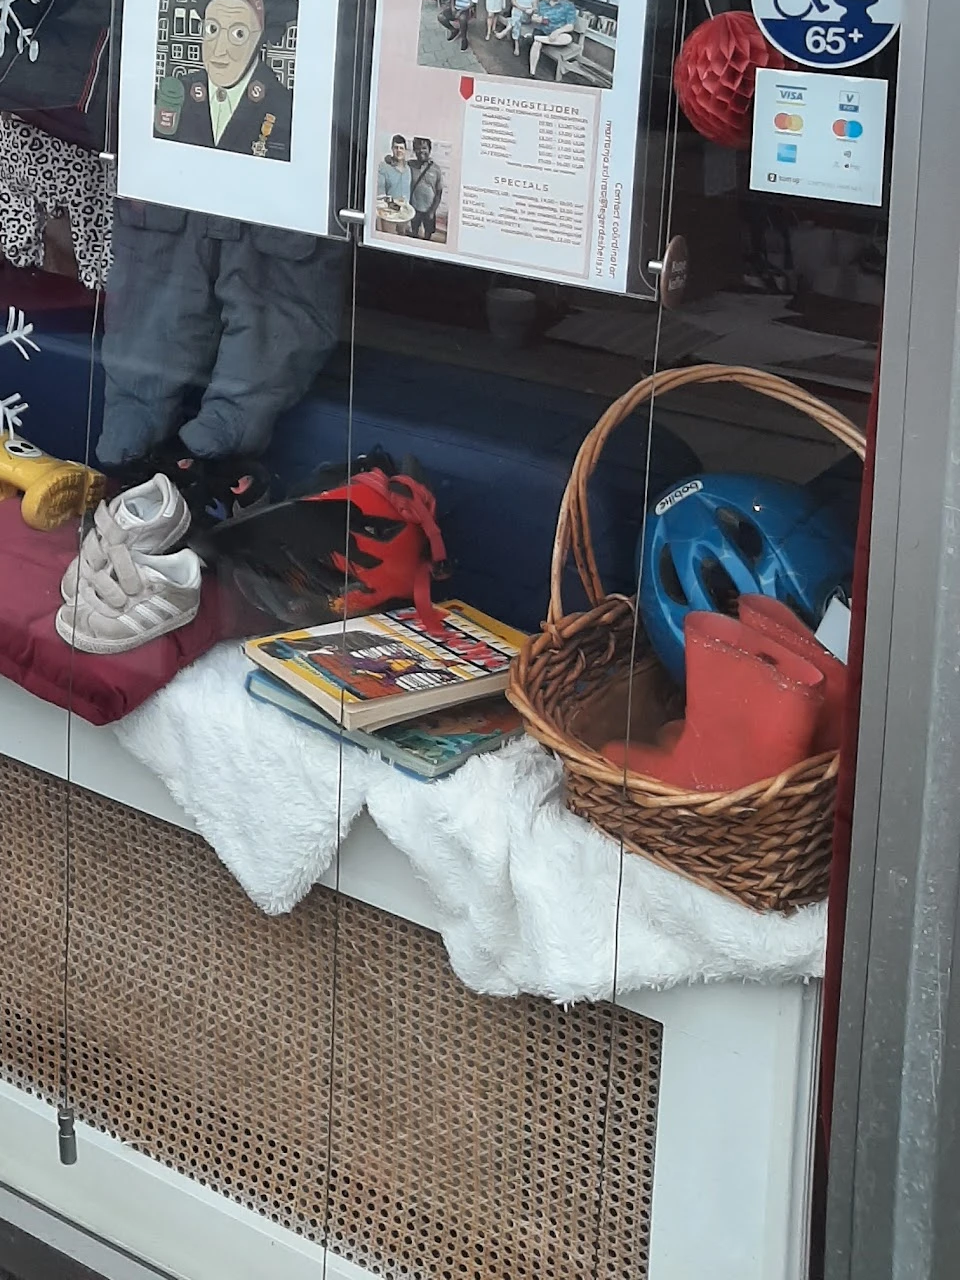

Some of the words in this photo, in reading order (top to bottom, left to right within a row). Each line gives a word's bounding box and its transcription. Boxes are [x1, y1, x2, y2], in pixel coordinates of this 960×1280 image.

[805, 26, 864, 55] 65+
[250, 85, 262, 98] S
[779, 90, 803, 100] VISA
[846, 94, 854, 103] V
[475, 94, 580, 116] OPENINGSTIJDEN
[494, 176, 549, 192] SPECIALS
[614, 182, 623, 219] Contact
